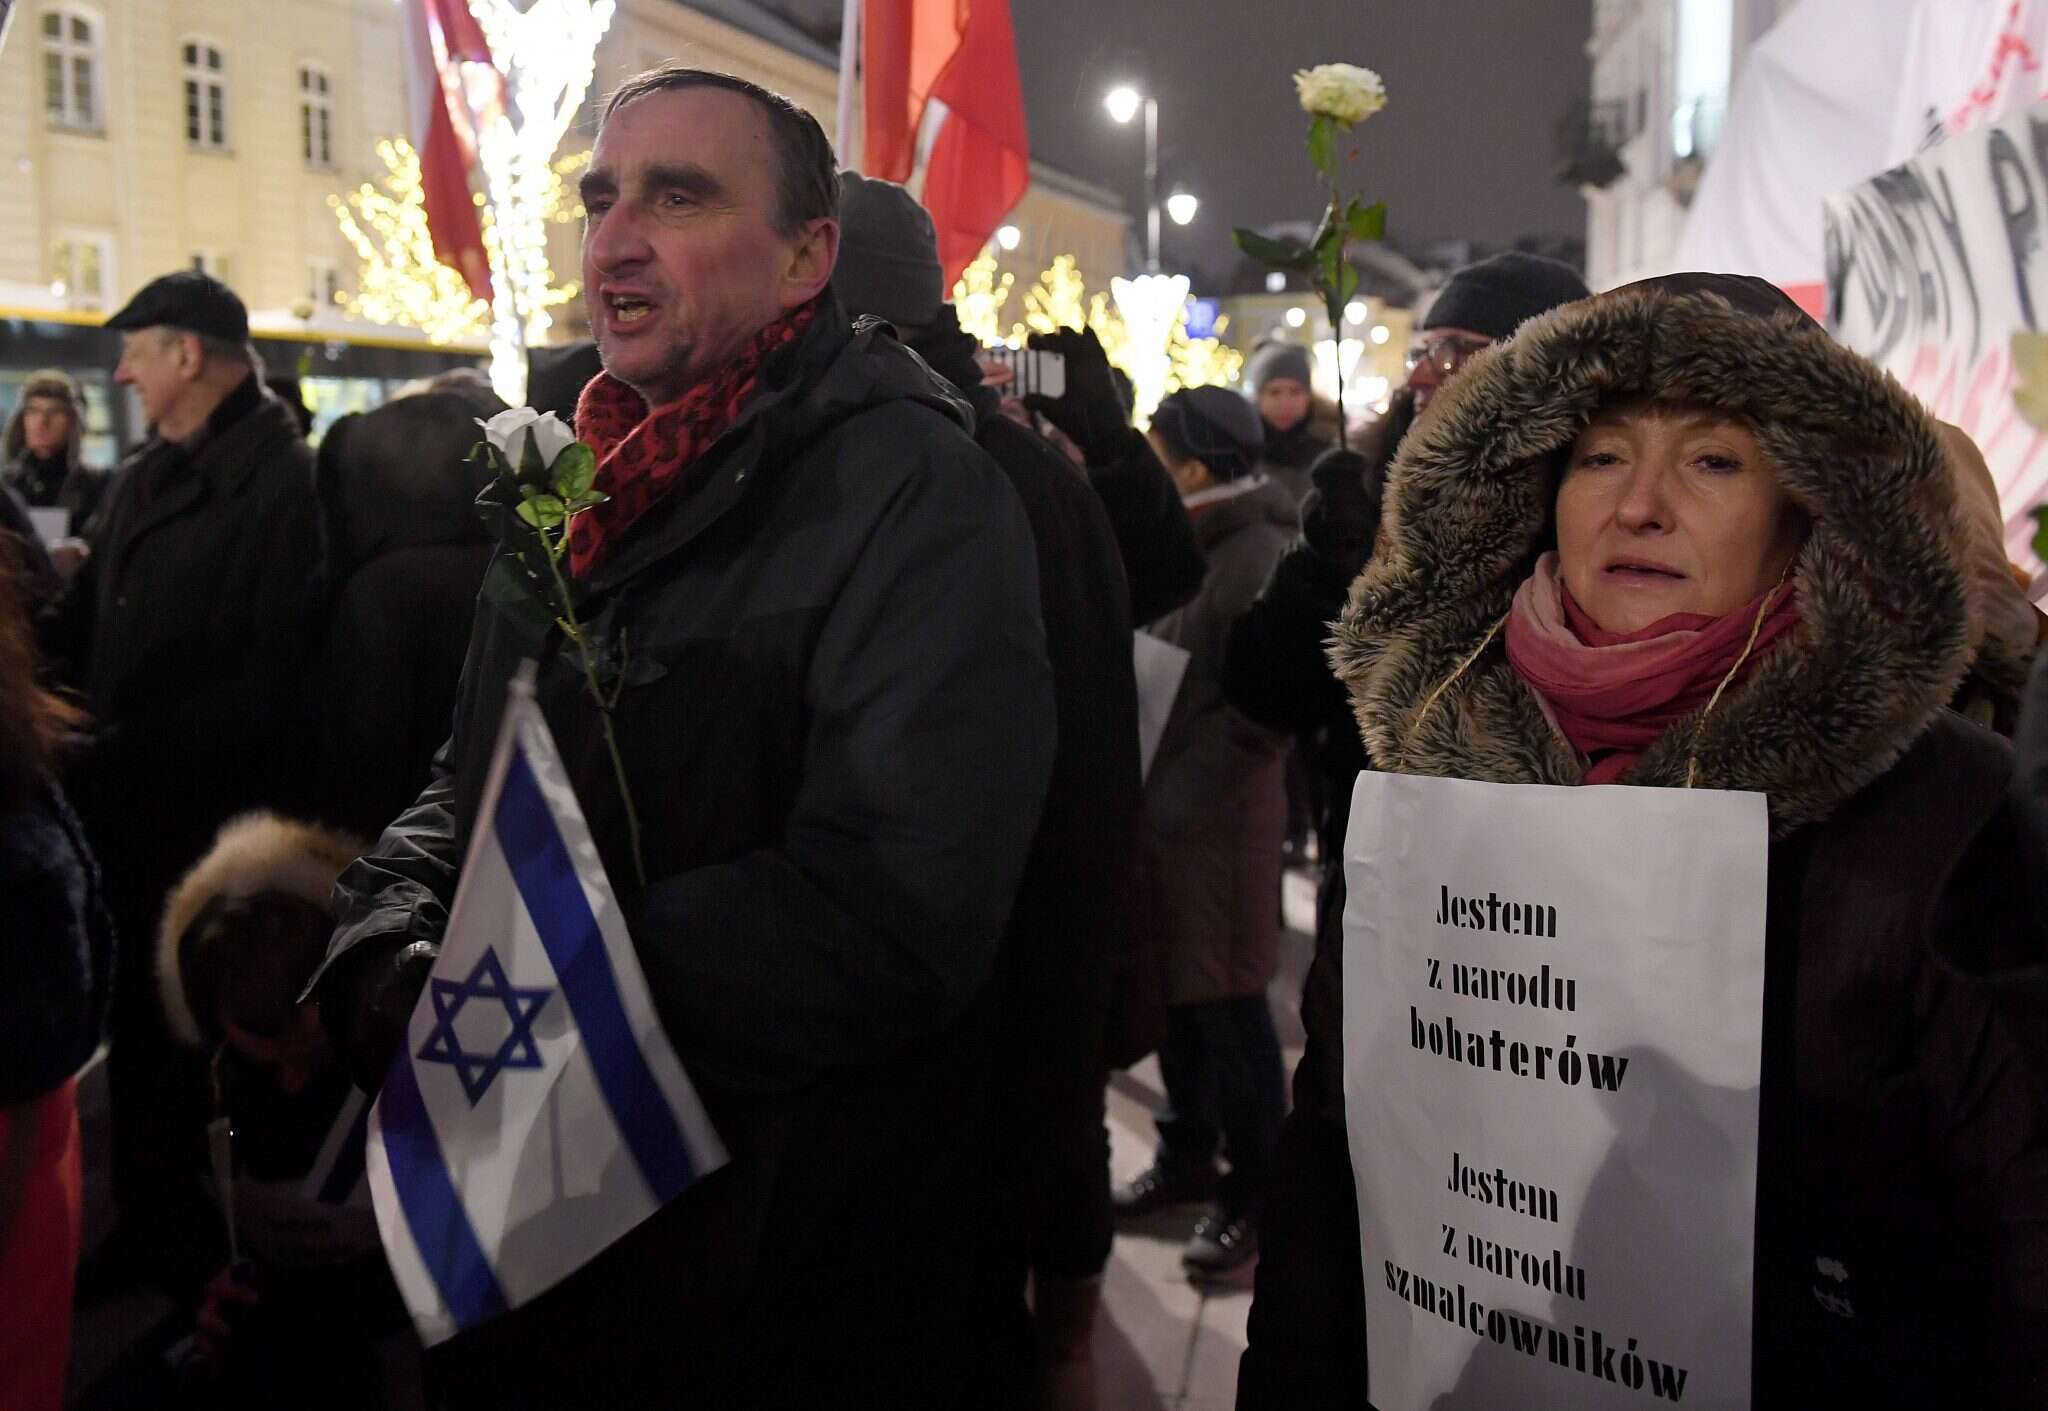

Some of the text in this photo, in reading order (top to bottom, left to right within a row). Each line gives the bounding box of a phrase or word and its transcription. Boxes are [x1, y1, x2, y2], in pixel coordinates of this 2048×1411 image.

[1435, 885, 1558, 939] Jestem
[1427, 957, 1577, 1012] z narodu
[1410, 1005, 1630, 1092] bohaterów
[1447, 1151, 1559, 1224] Jestem
[1442, 1224, 1586, 1302] z narodu
[1384, 1259, 1689, 1404] szmalcowników
